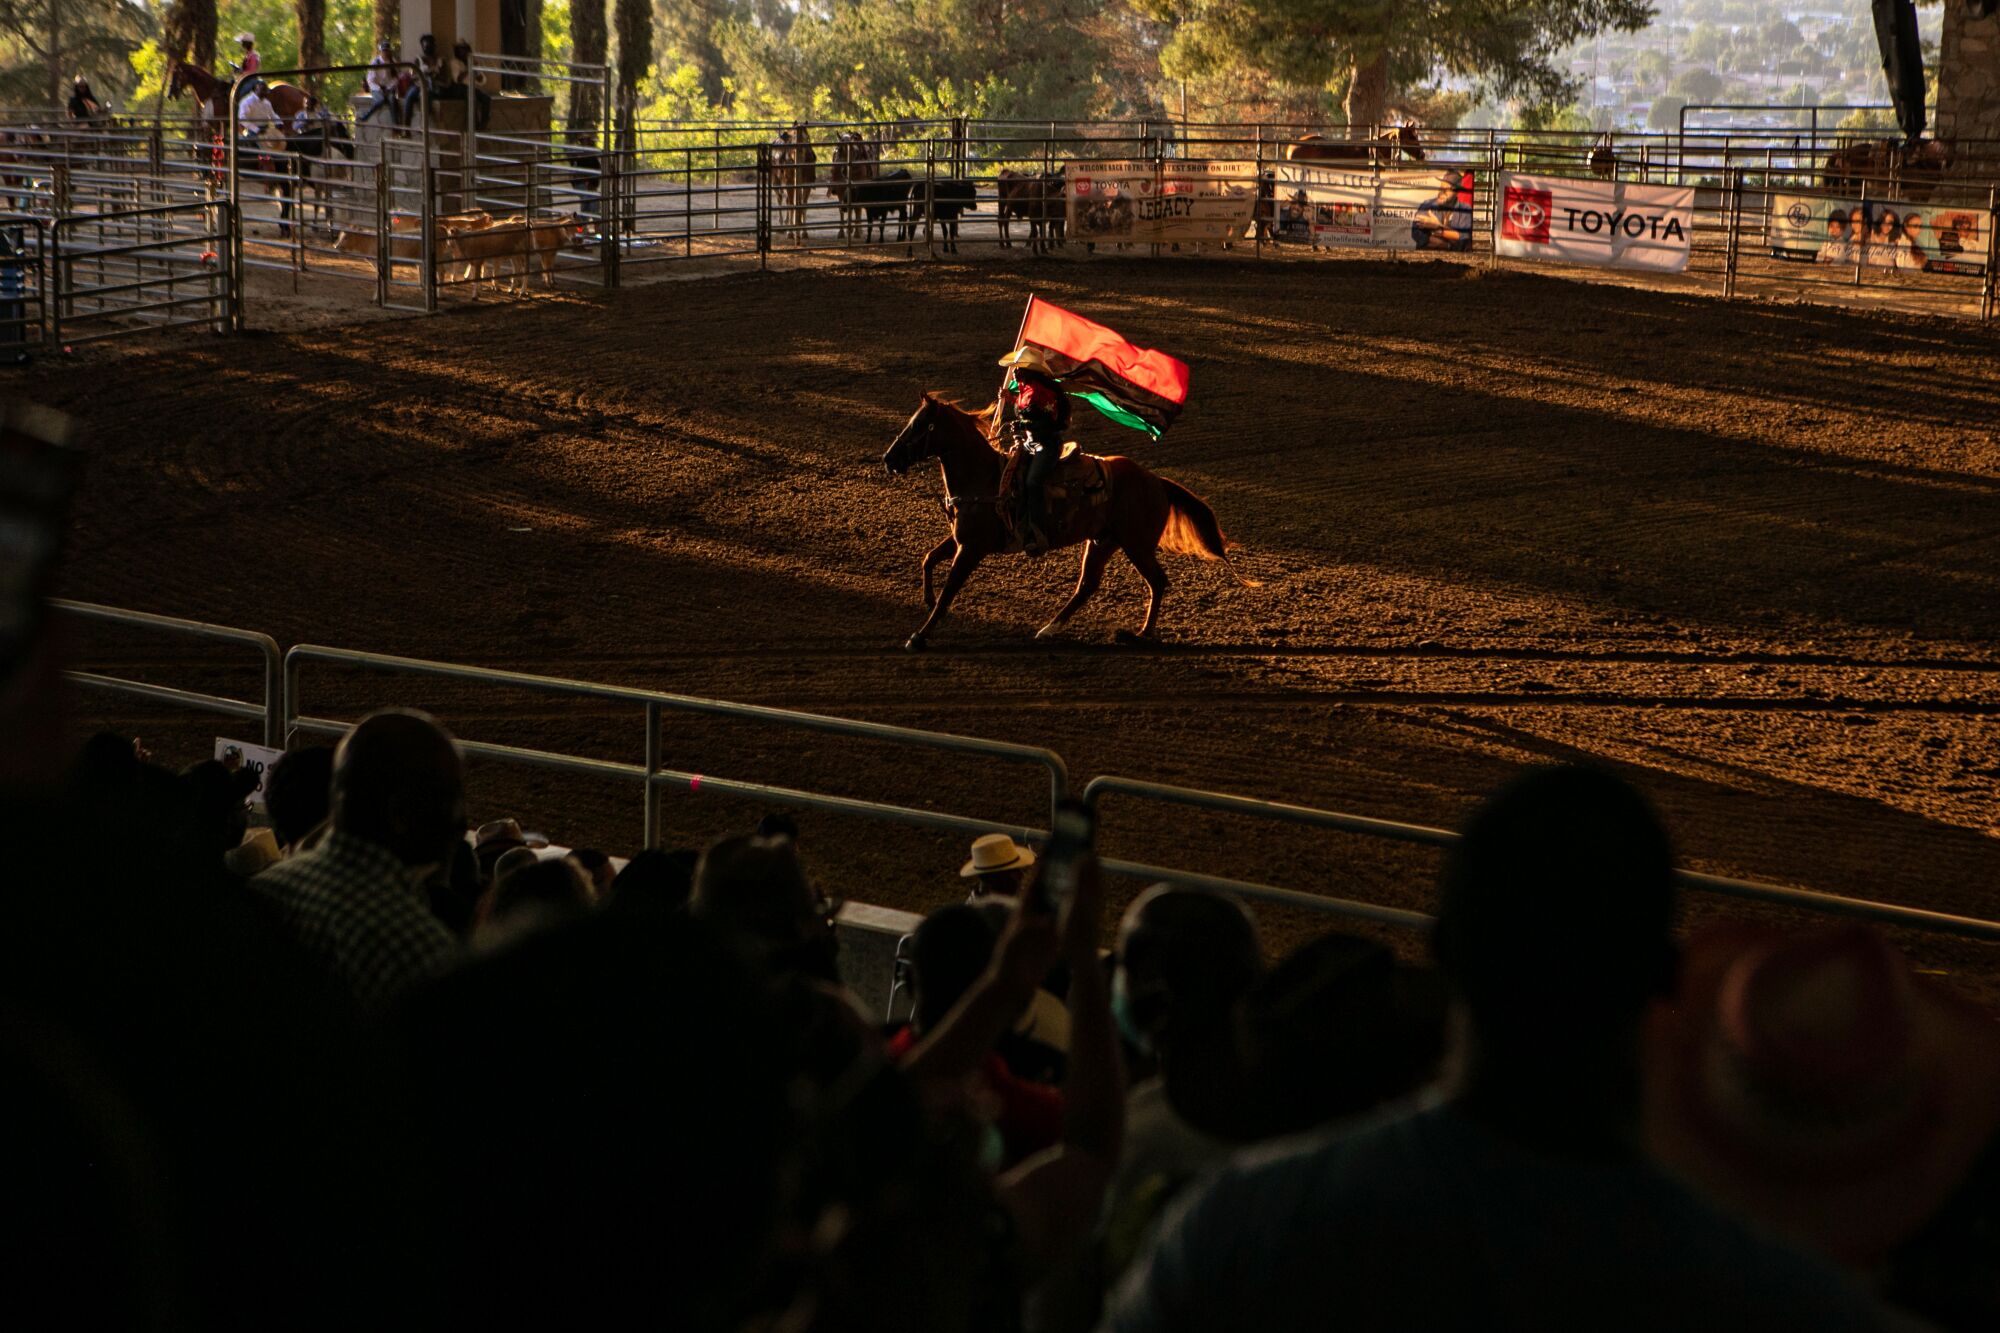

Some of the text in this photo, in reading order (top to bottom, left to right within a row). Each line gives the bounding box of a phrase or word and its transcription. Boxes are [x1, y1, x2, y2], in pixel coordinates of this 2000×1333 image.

[1079, 163, 1107, 172] WELCOME
[1109, 163, 1122, 172] BACK
[1124, 163, 1132, 172] TO
[1133, 163, 1143, 172] THE
[1187, 164, 1209, 173] SHOW
[1211, 164, 1221, 172] ON
[1096, 180, 1130, 190] TOYOTA
[1138, 197, 1194, 221] LEGACY
[1372, 209, 1414, 218] KADEEM
[1563, 208, 1686, 242] TOYOTA
[246, 759, 264, 776] NO
